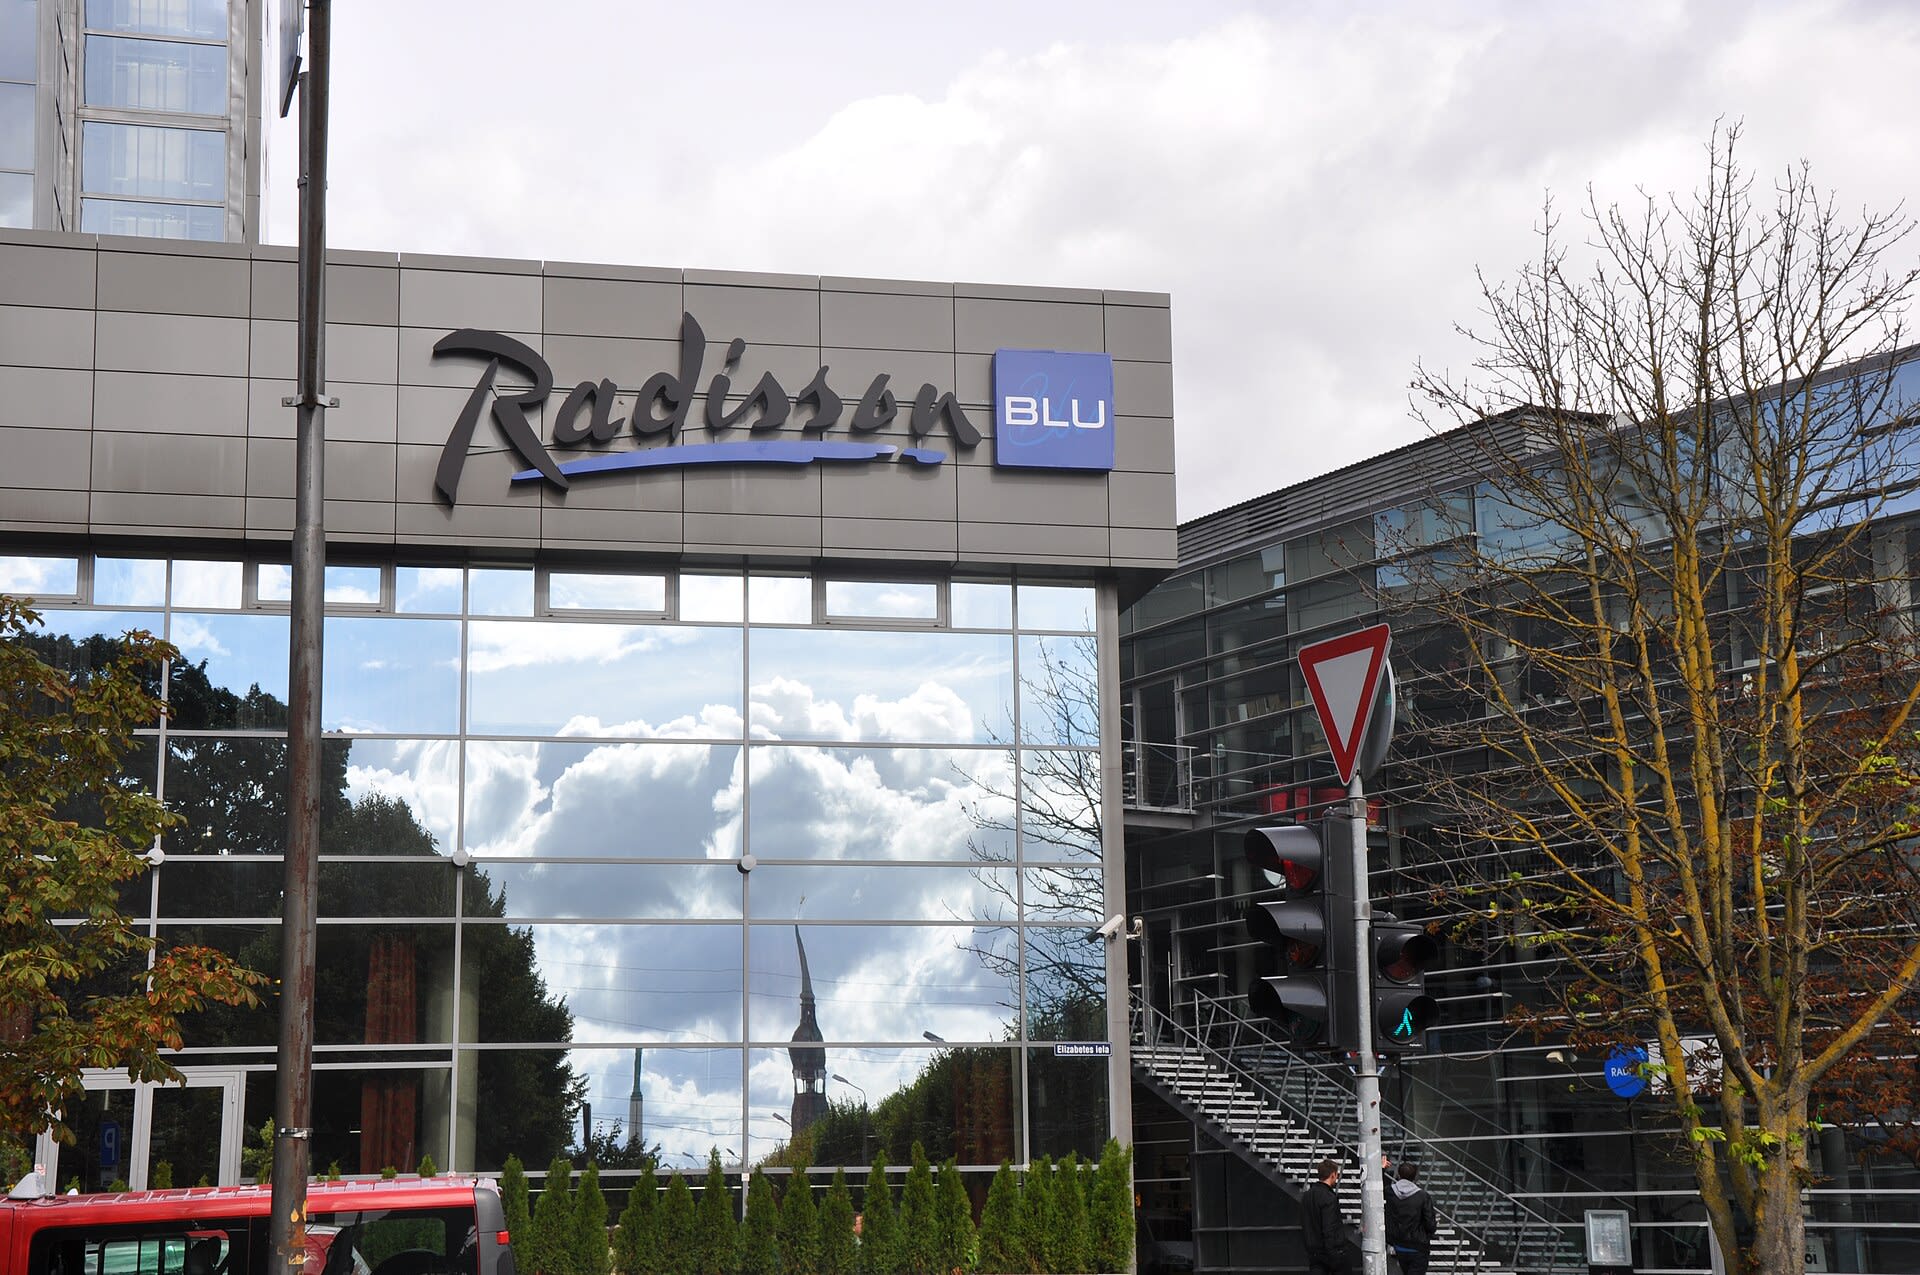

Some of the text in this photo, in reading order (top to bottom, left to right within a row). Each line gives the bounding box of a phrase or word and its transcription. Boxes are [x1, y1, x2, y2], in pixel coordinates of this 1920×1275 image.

[432, 312, 1105, 506] Radisson BLU
[1057, 1044, 1094, 1054] Elizabetes
